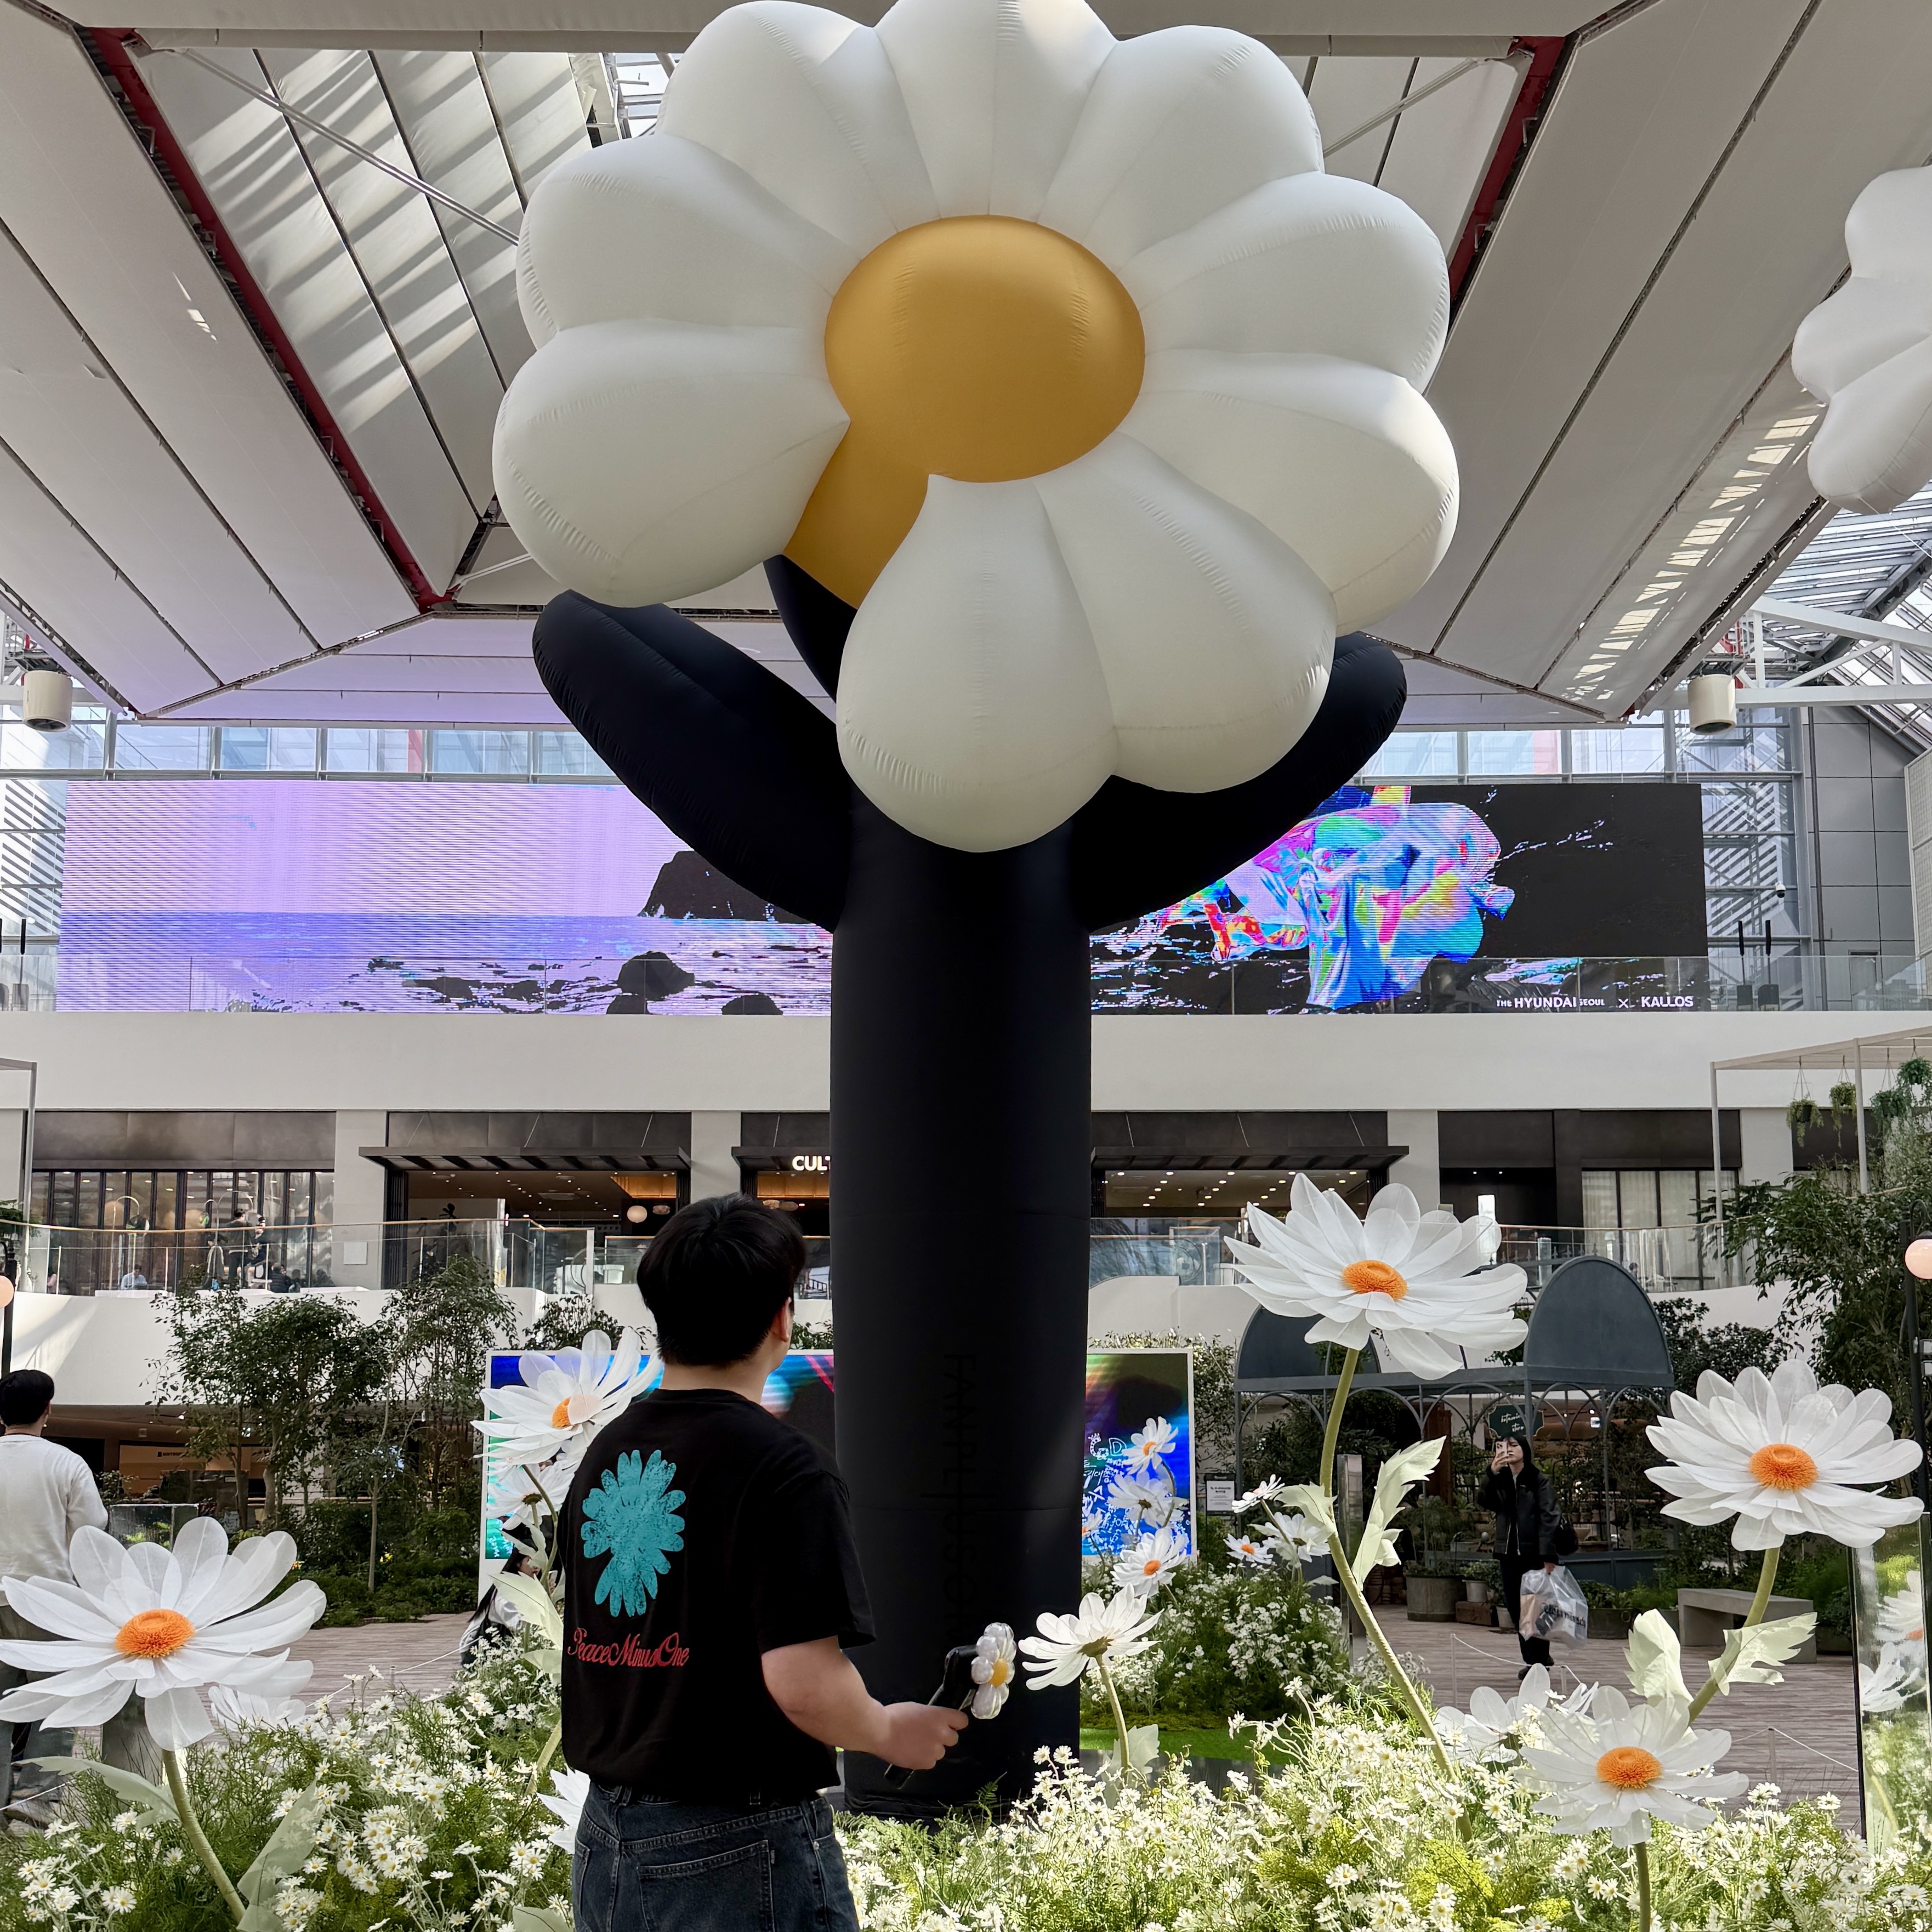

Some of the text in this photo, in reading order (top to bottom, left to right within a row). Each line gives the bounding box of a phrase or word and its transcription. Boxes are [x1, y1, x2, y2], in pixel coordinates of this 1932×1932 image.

[1514, 997, 1576, 1008] HYUNDAI
[1641, 996, 1694, 1008] KALLOS
[567, 1627, 690, 1667] PeaceMinusOne
